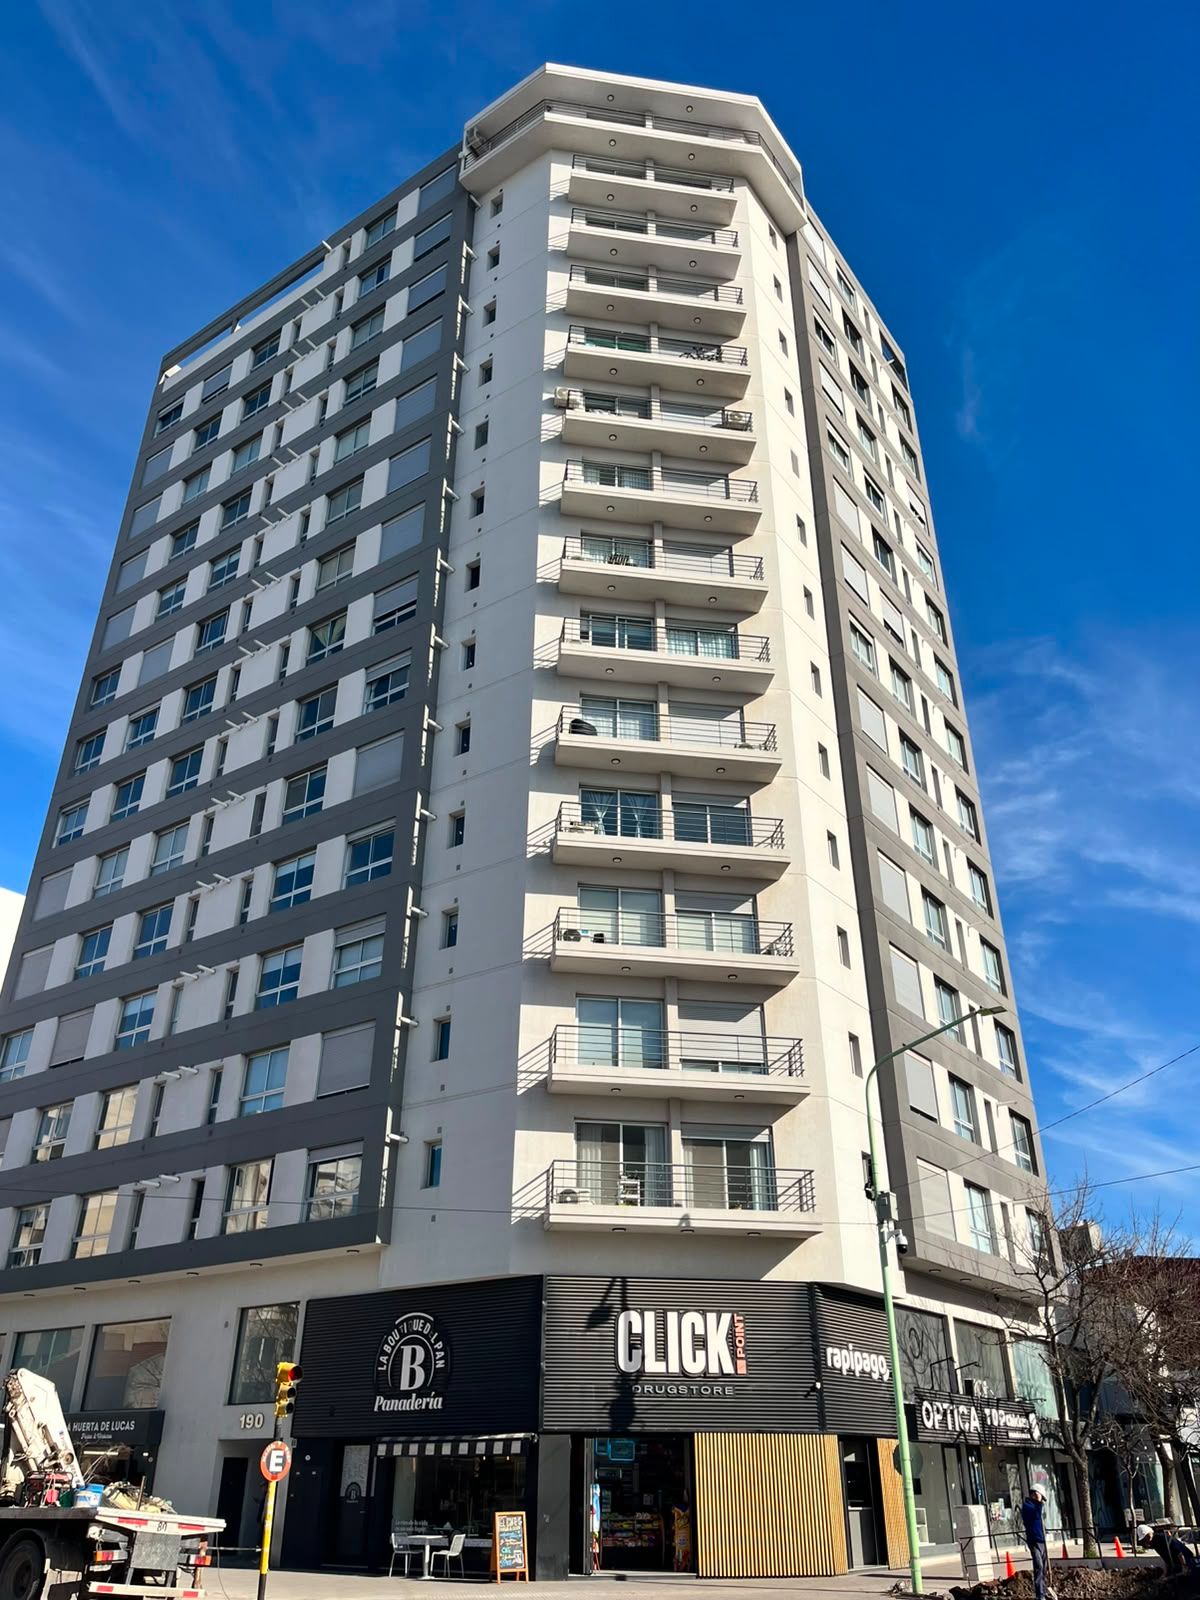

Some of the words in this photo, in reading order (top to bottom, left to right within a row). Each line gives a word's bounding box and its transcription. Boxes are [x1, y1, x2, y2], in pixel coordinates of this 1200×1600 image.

[617, 1310, 735, 1374] CLICK
[734, 1313, 746, 1358] POINT
[377, 1355, 389, 1371] LA
[433, 1340, 446, 1369] PAN
[400, 1344, 426, 1391] B
[826, 1343, 888, 1381] rapipago
[373, 1391, 443, 1412] Panadería
[631, 1384, 735, 1396] DRUGSTORE
[72, 1421, 99, 1432] HUERTA
[100, 1420, 110, 1432] DE
[111, 1419, 136, 1431] LUCAS
[239, 1412, 264, 1429] 190
[921, 1400, 981, 1433] OPTICA
[269, 1449, 285, 1472] E
